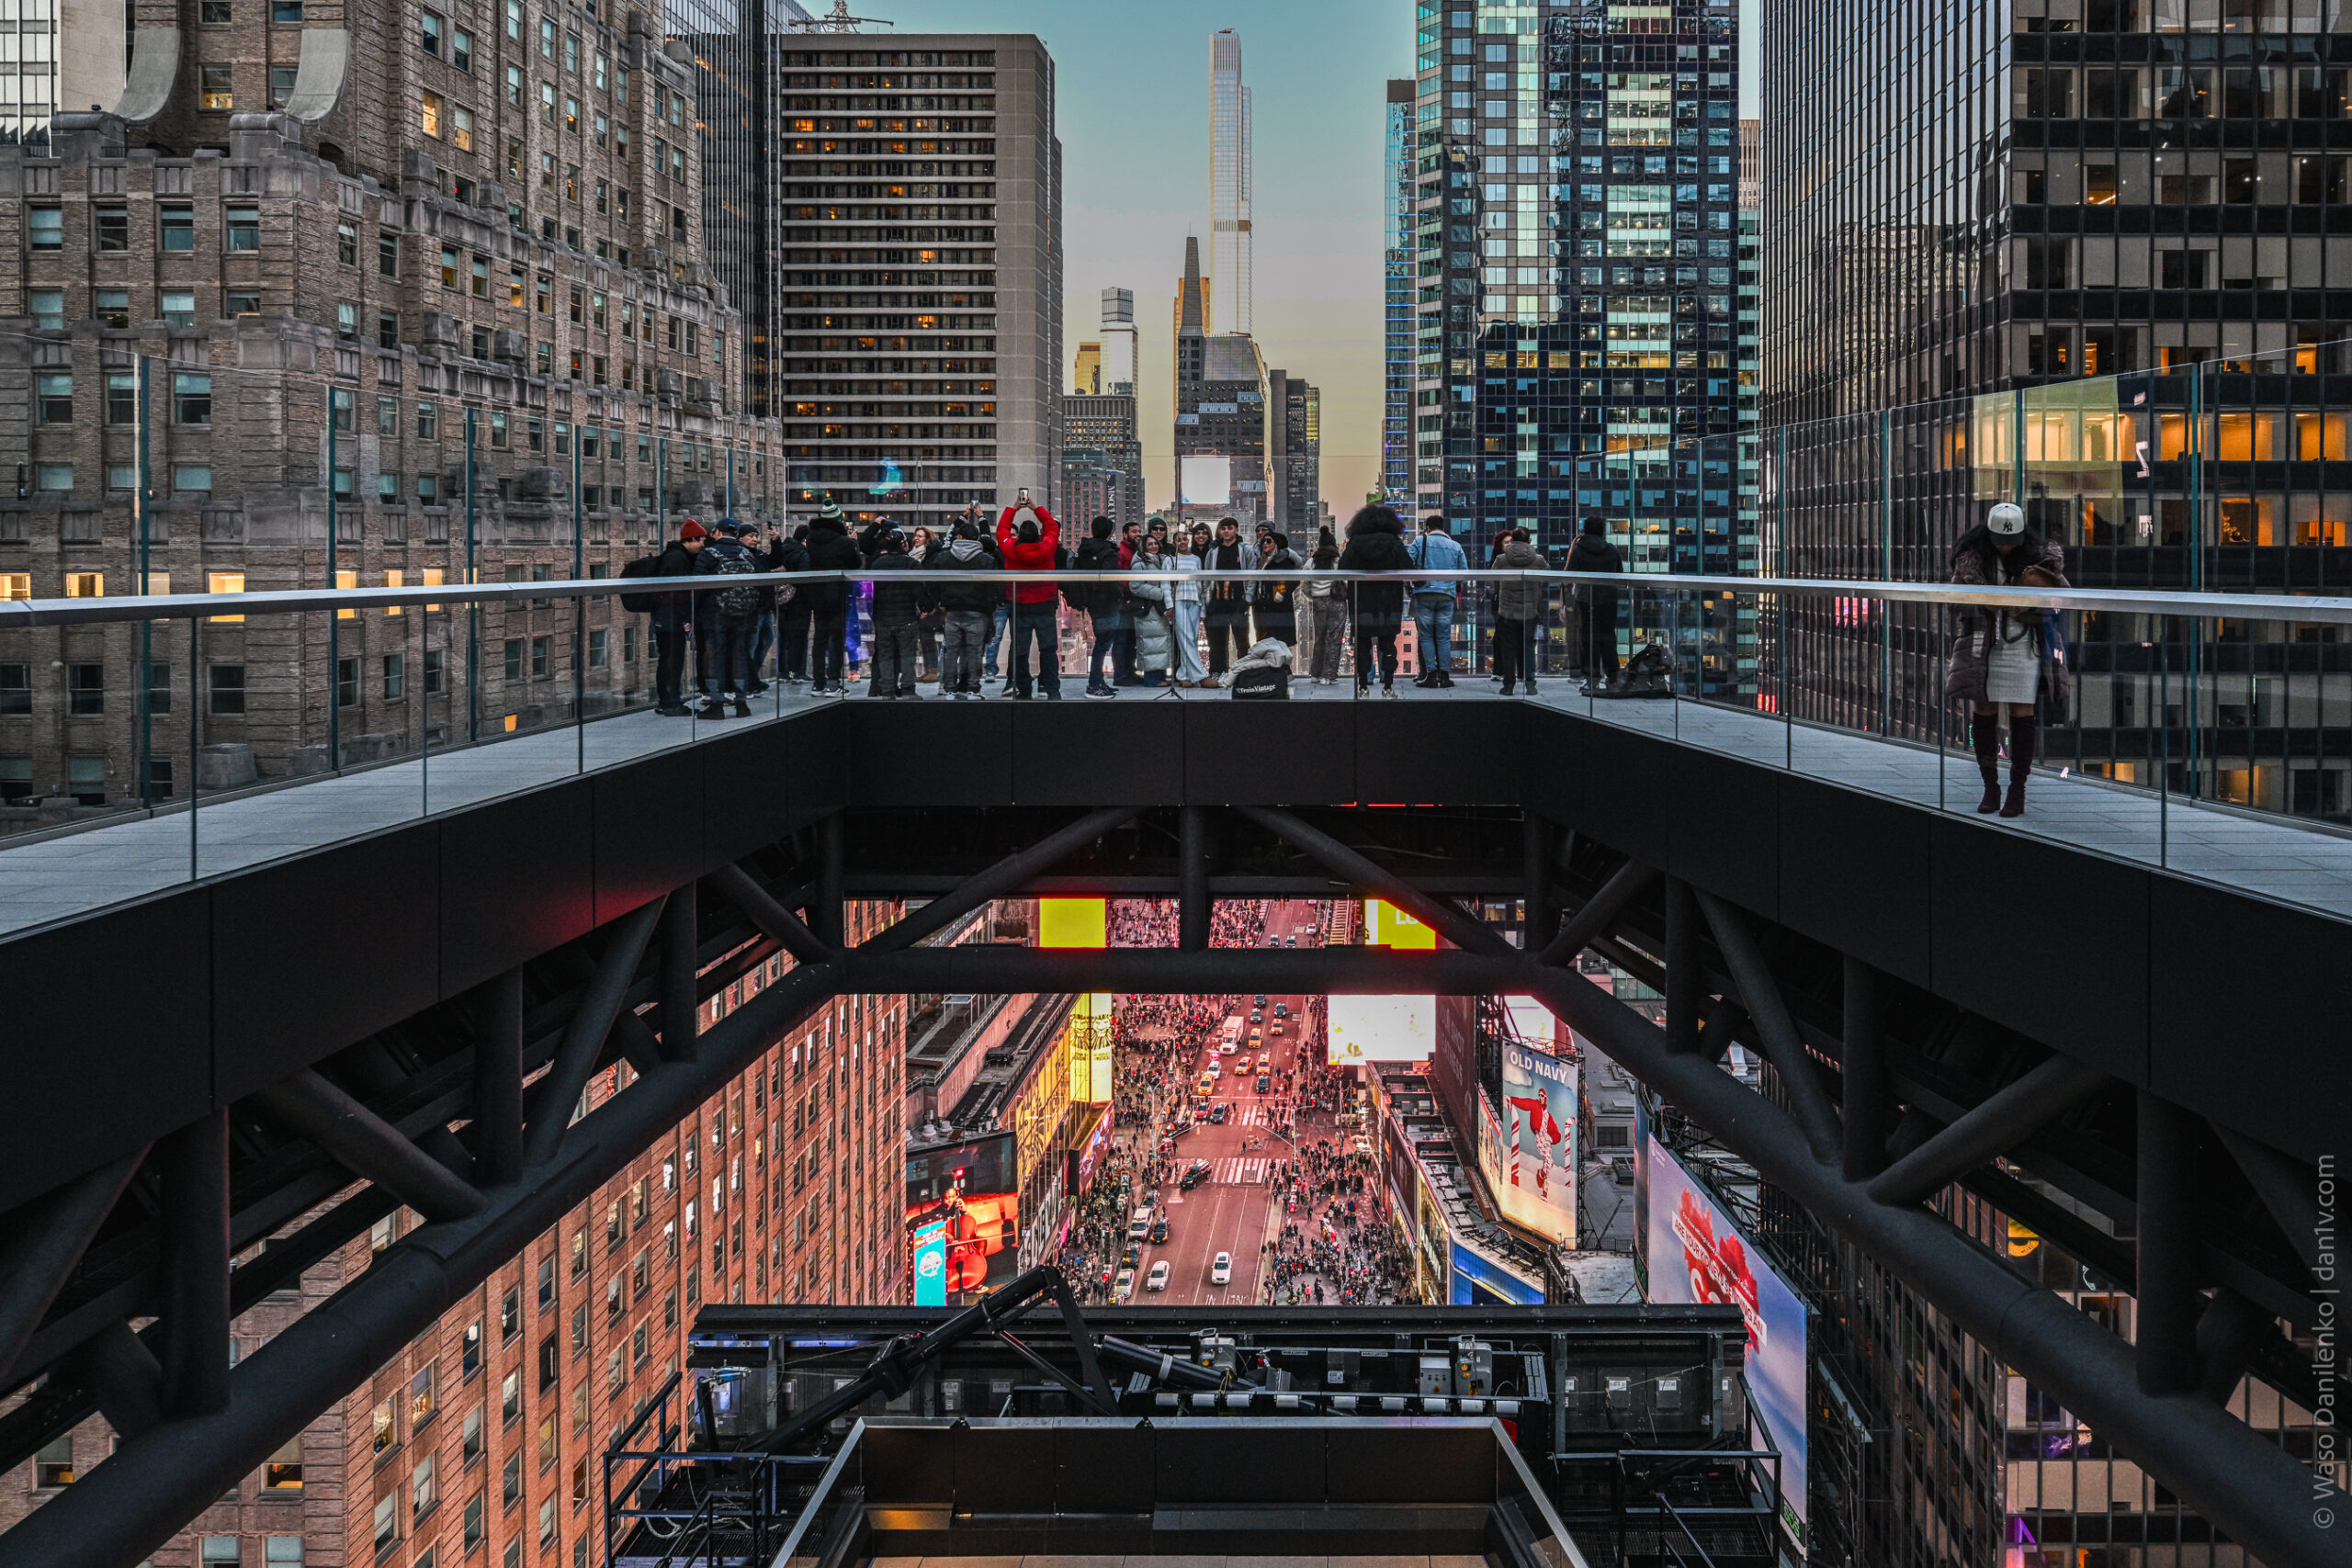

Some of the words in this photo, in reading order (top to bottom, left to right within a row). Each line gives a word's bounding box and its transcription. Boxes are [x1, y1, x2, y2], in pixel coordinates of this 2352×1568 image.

[1510, 1051, 1533, 1071] OLD
[1535, 1059, 1568, 1084] NAVY
[1675, 1219, 1685, 1238] ARE
[1685, 1231, 1700, 1257] YOUR
[1753, 1315, 1763, 1336] AN
